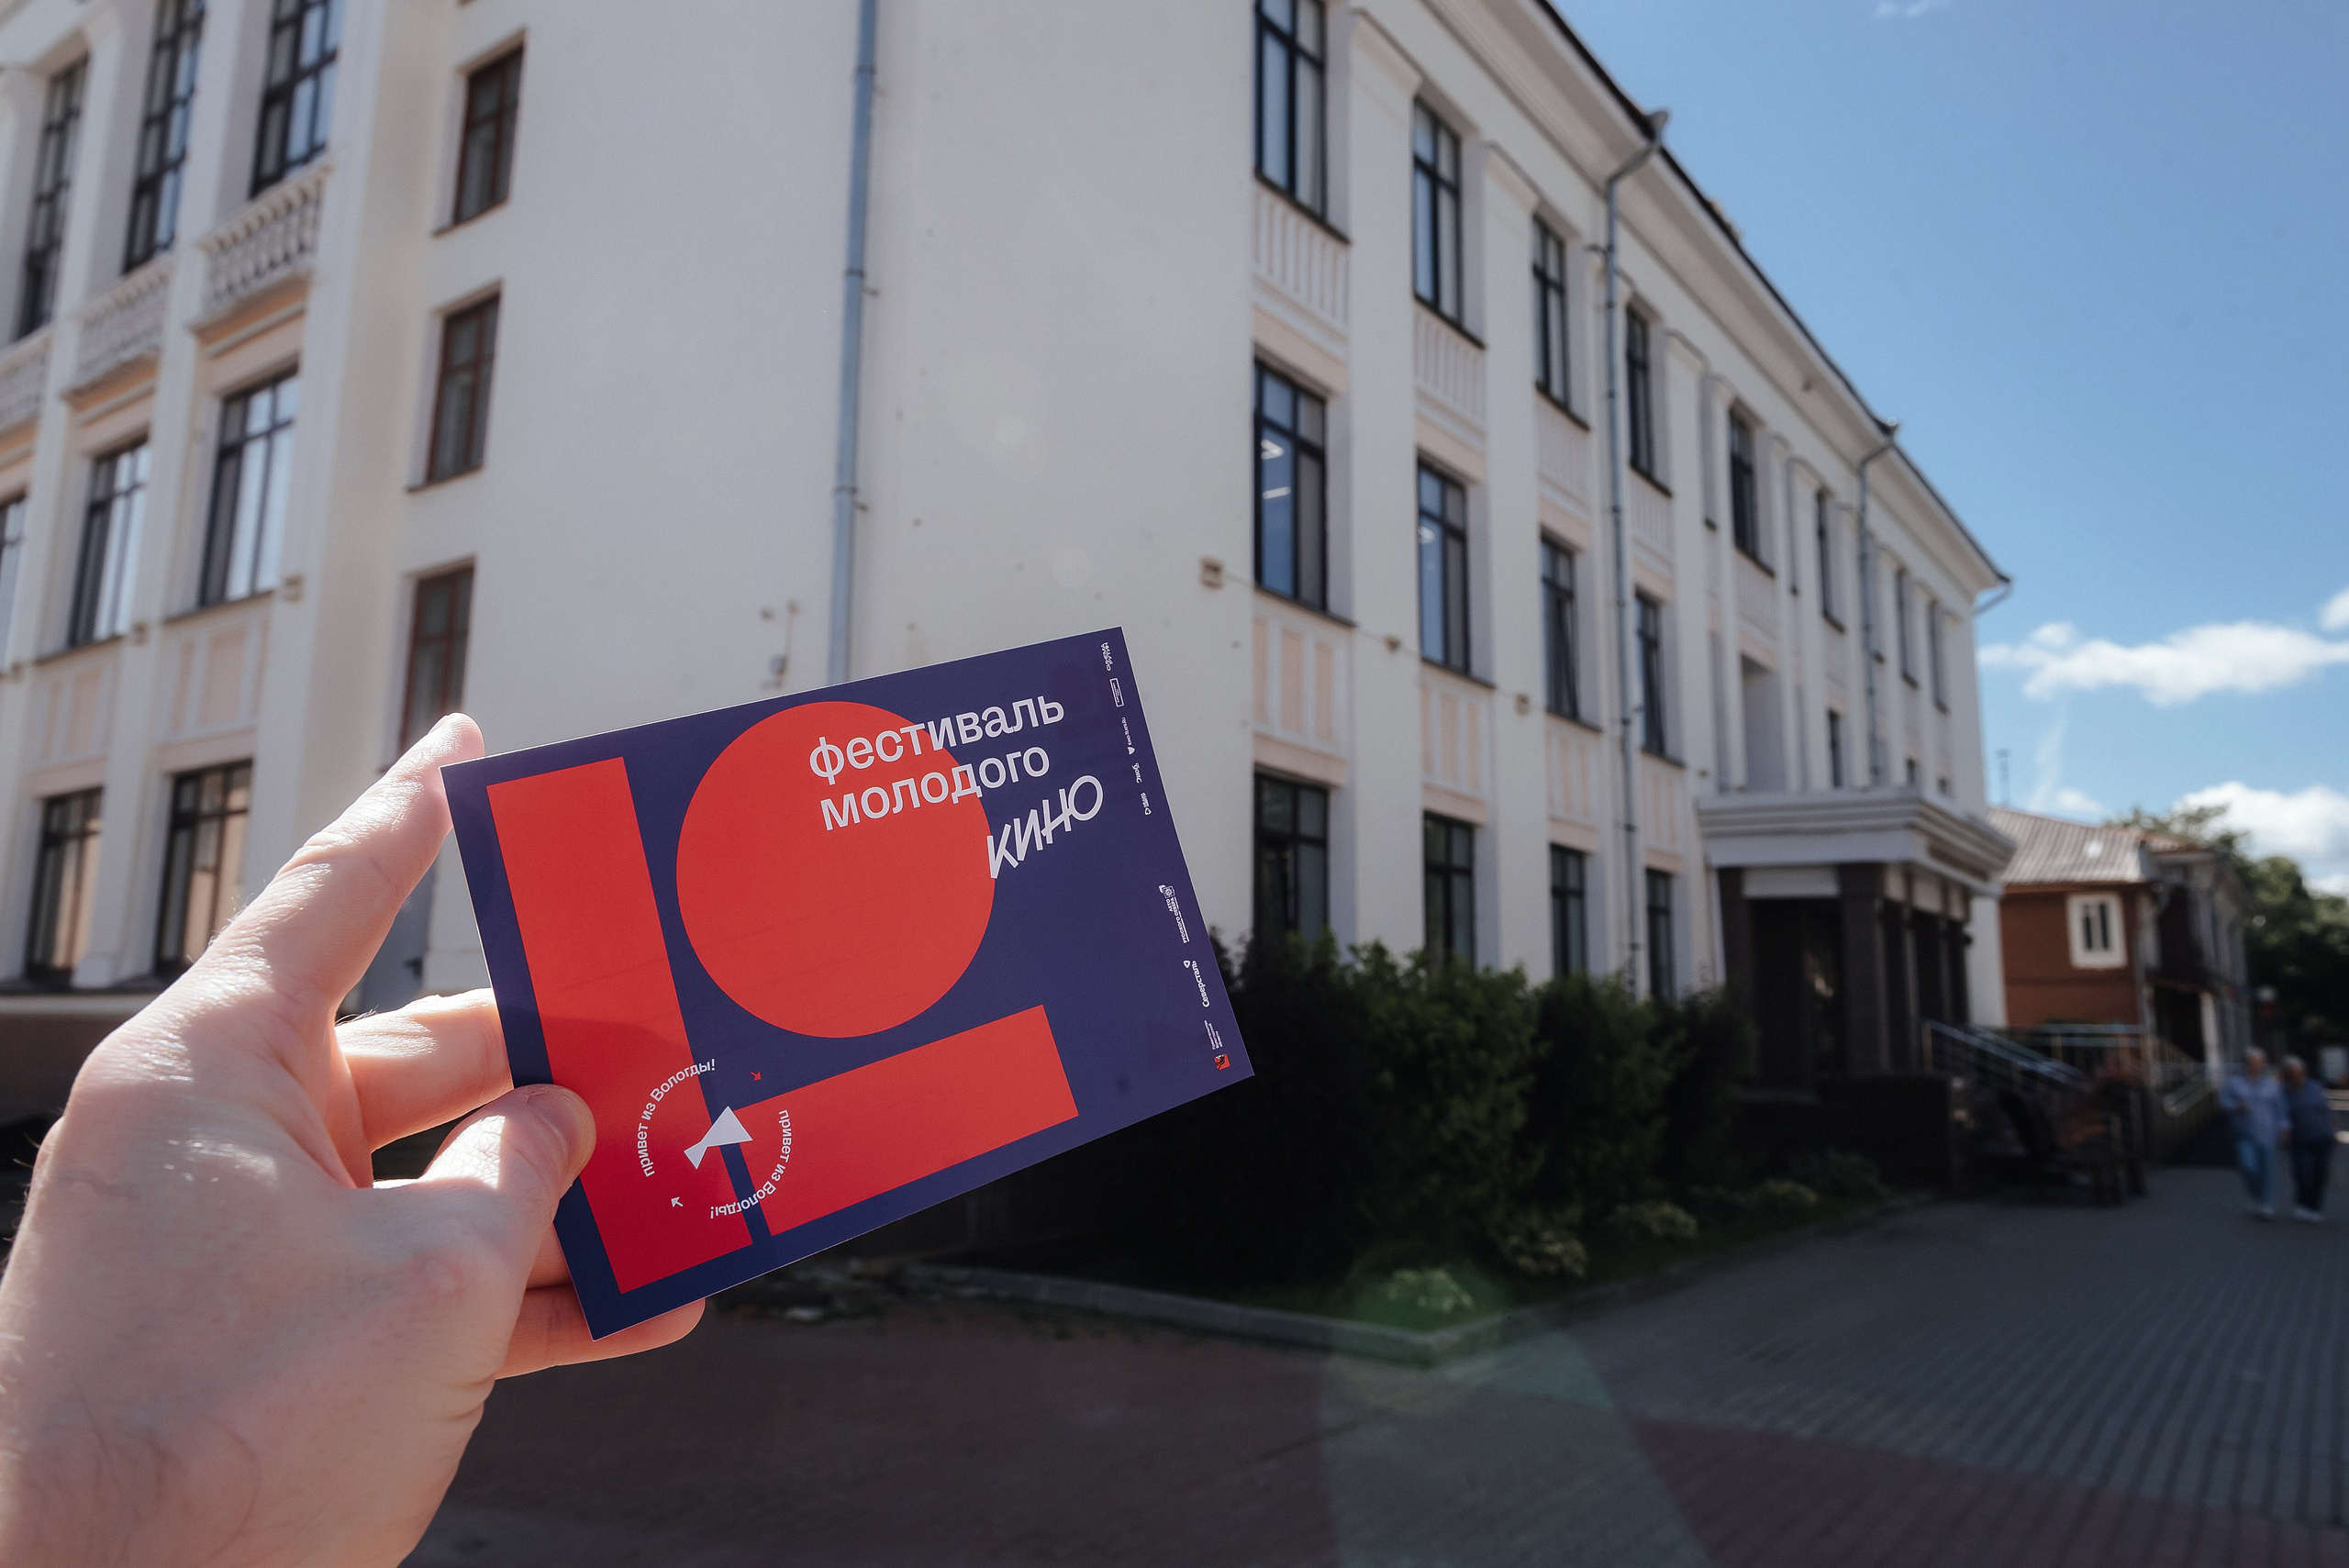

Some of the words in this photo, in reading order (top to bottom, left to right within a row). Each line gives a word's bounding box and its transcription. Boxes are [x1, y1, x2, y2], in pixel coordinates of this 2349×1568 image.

[809, 695, 1064, 785] фестиваль
[820, 746, 1050, 831] молодого
[1192, 960, 1210, 1007] Северсталь
[650, 1059, 716, 1102] Вологды!
[641, 1102, 656, 1121] из
[638, 1122, 655, 1177] привет
[778, 1109, 792, 1162] привет
[771, 1163, 786, 1182] из
[710, 1181, 777, 1218] Вологды!
